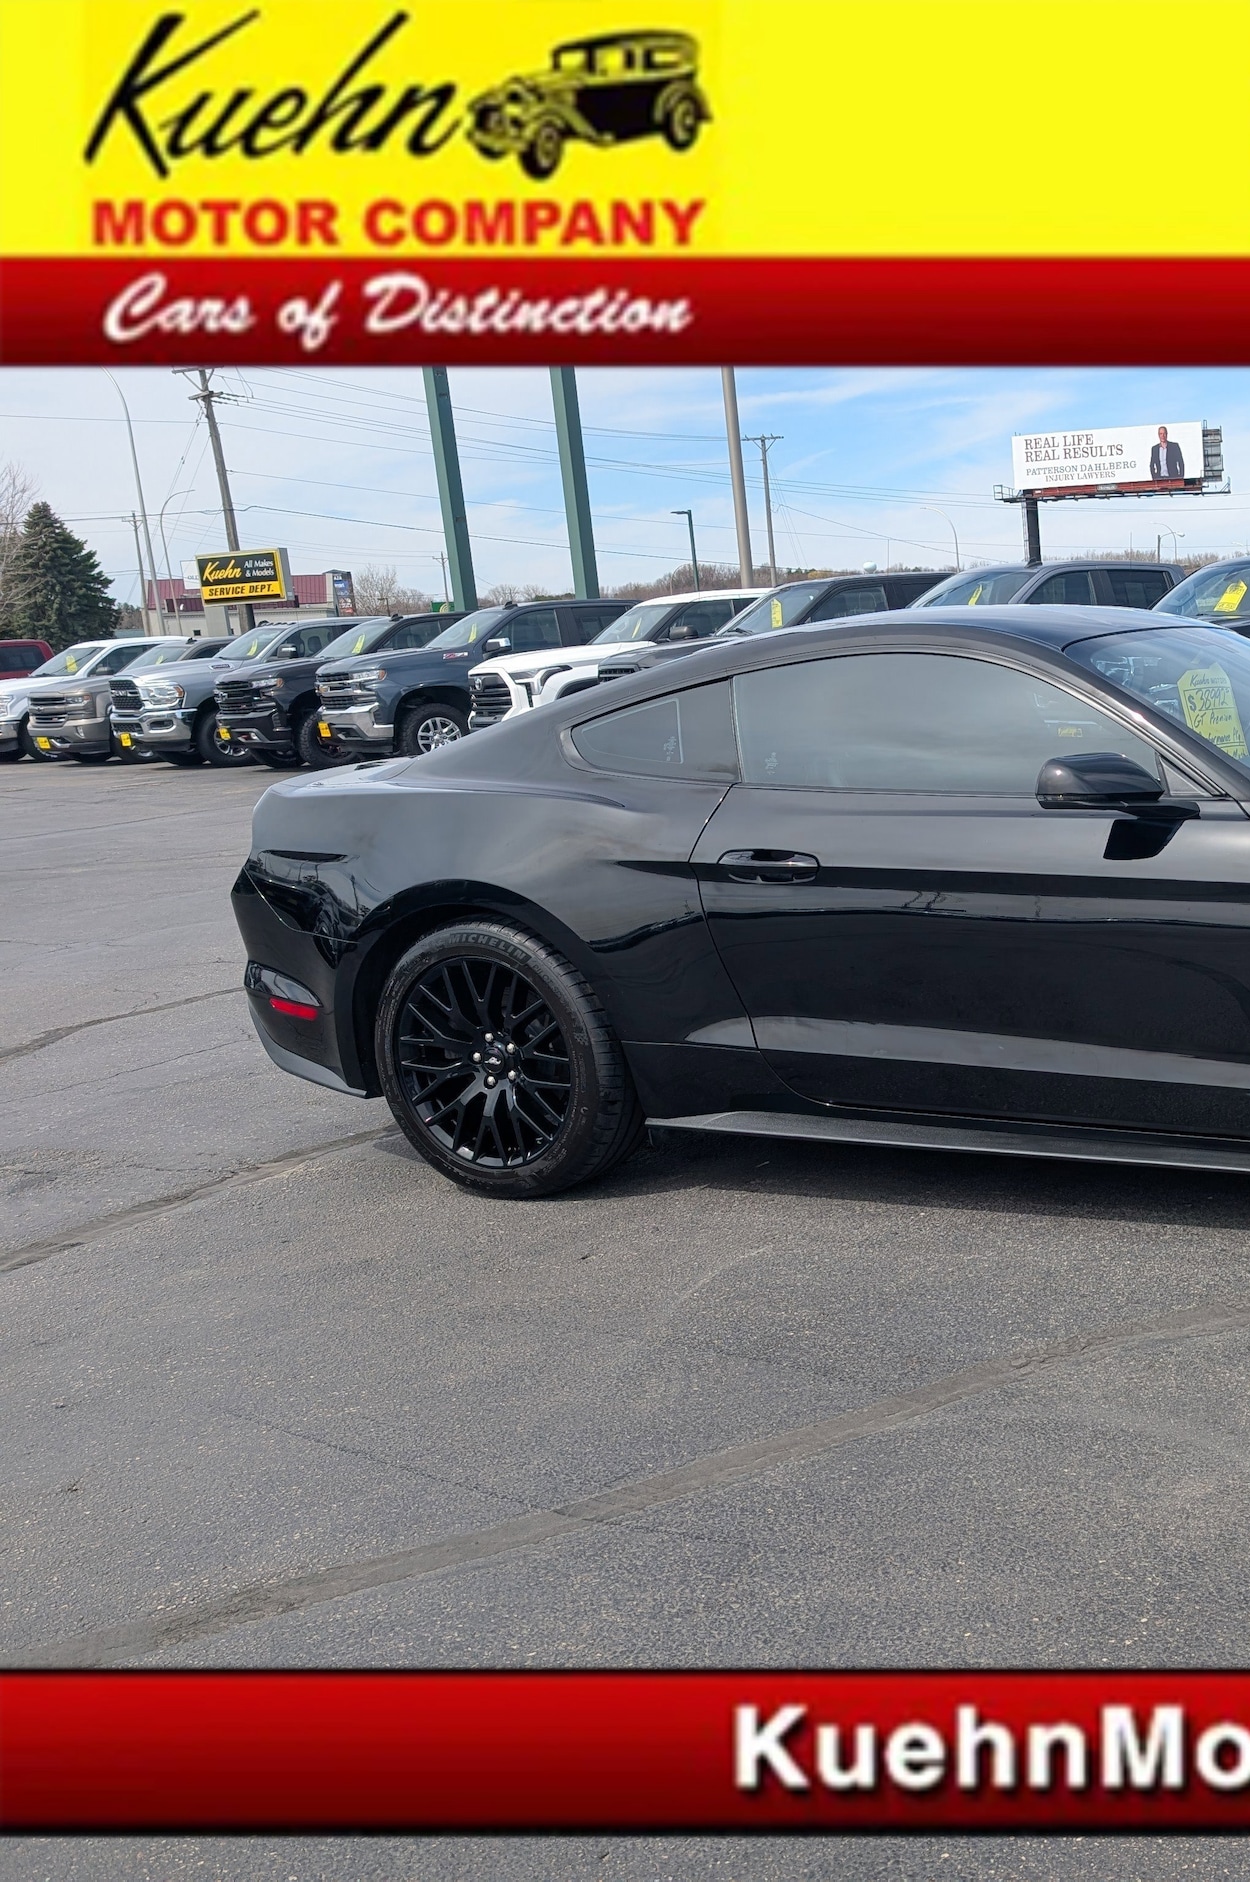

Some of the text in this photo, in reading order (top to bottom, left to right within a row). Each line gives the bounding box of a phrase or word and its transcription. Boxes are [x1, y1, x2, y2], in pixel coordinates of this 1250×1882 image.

[1024, 434, 1094, 450] REAL LIFE
[1025, 444, 1124, 463] REAL RESULTS
[1026, 460, 1137, 476] PATTERSON DAHLBERG
[1045, 471, 1116, 482] INJURY LAWYERS
[203, 559, 242, 582] Kuehn
[252, 568, 275, 576] Models
[208, 583, 274, 597] SERVICE DEPT.
[1194, 712, 1206, 728] GT
[450, 933, 527, 960] MICHELIN
